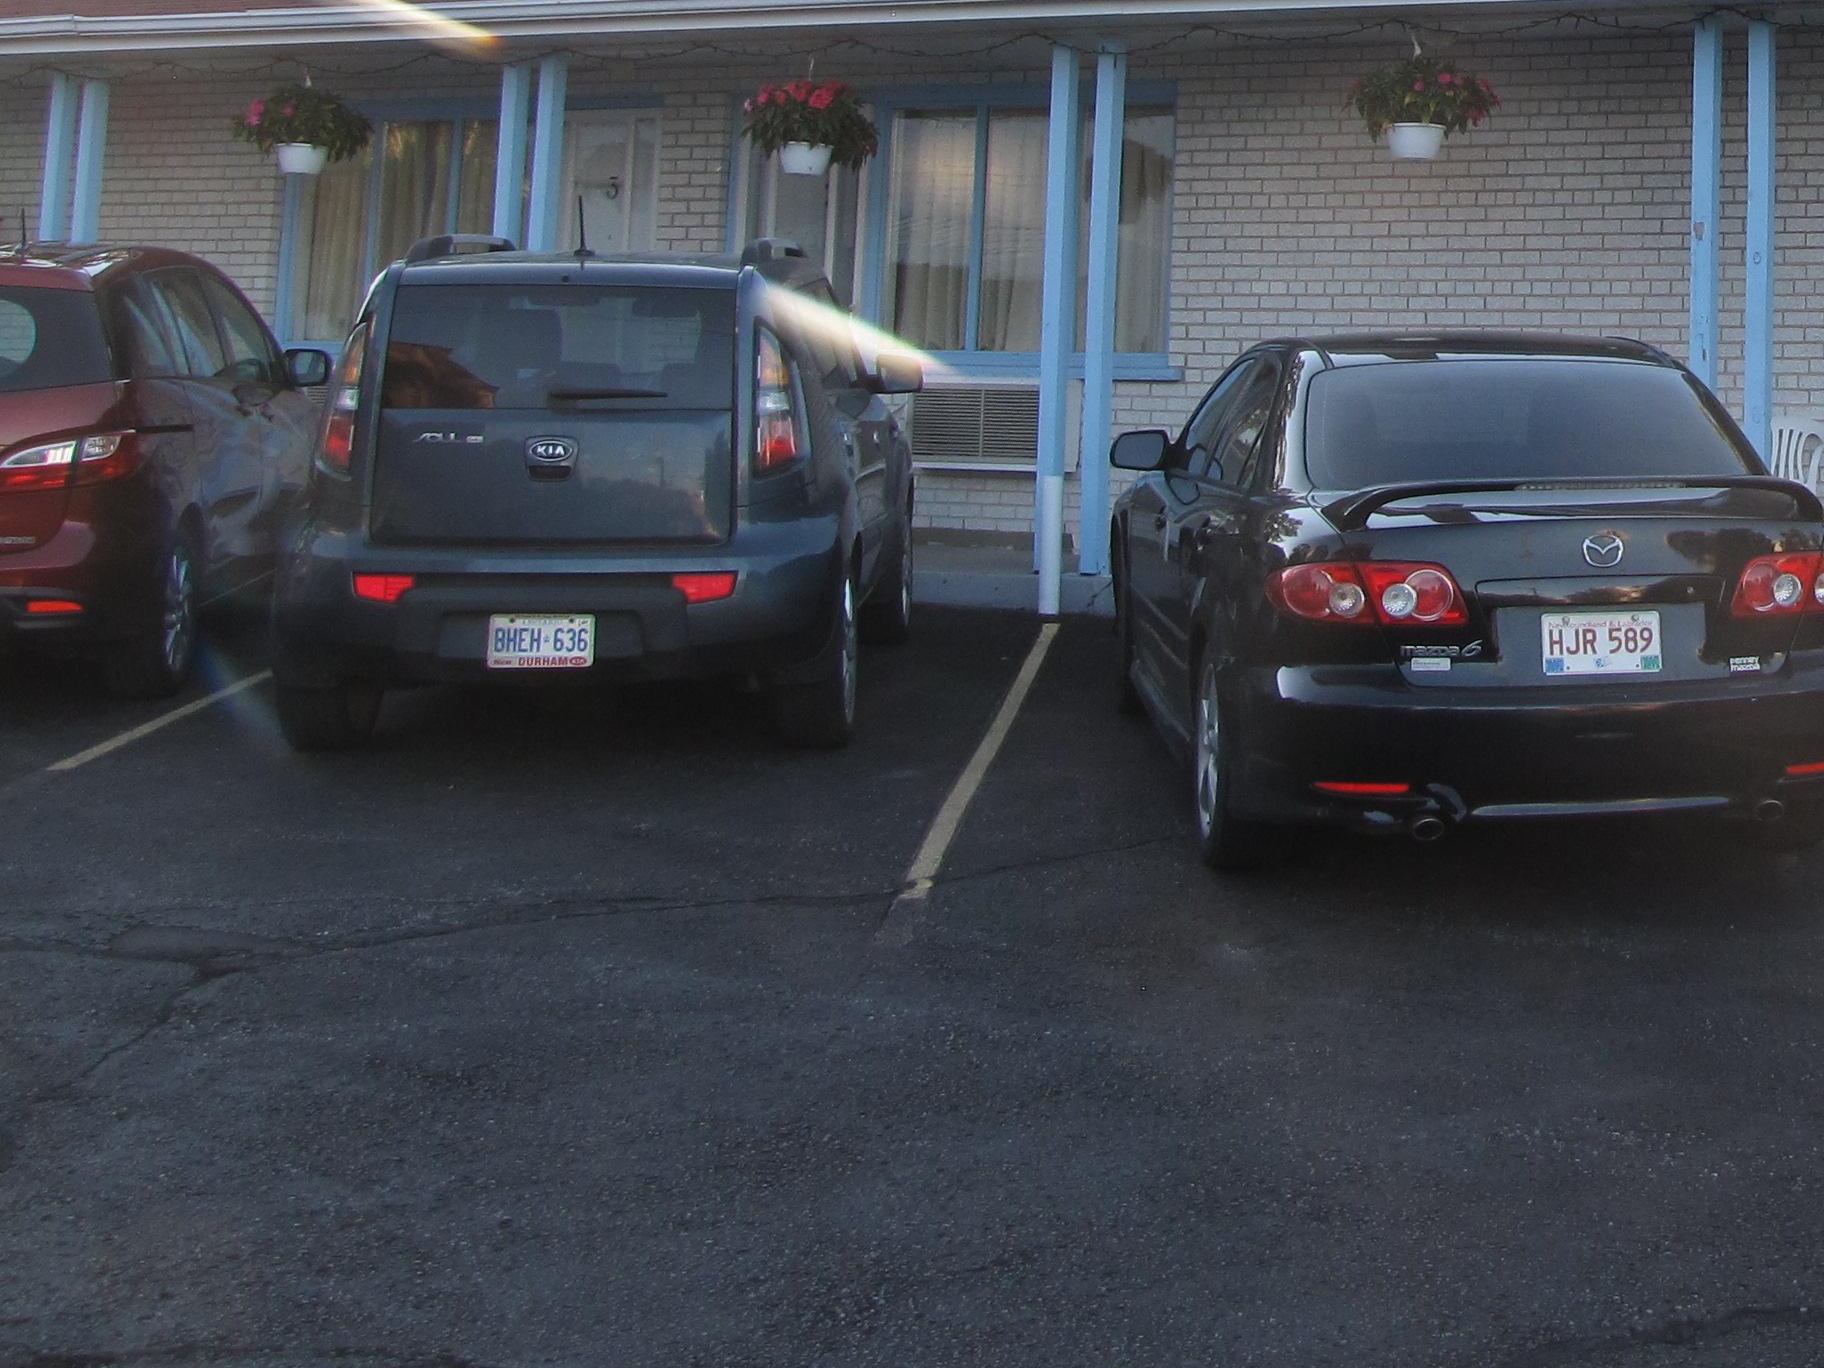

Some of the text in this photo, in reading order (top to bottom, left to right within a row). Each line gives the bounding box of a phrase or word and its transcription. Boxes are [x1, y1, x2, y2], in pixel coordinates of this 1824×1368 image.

[536, 445, 565, 457] KIA
[553, 628, 589, 652] 636
[1548, 627, 1653, 656] HJR 589
[518, 657, 569, 666] DURHAM
